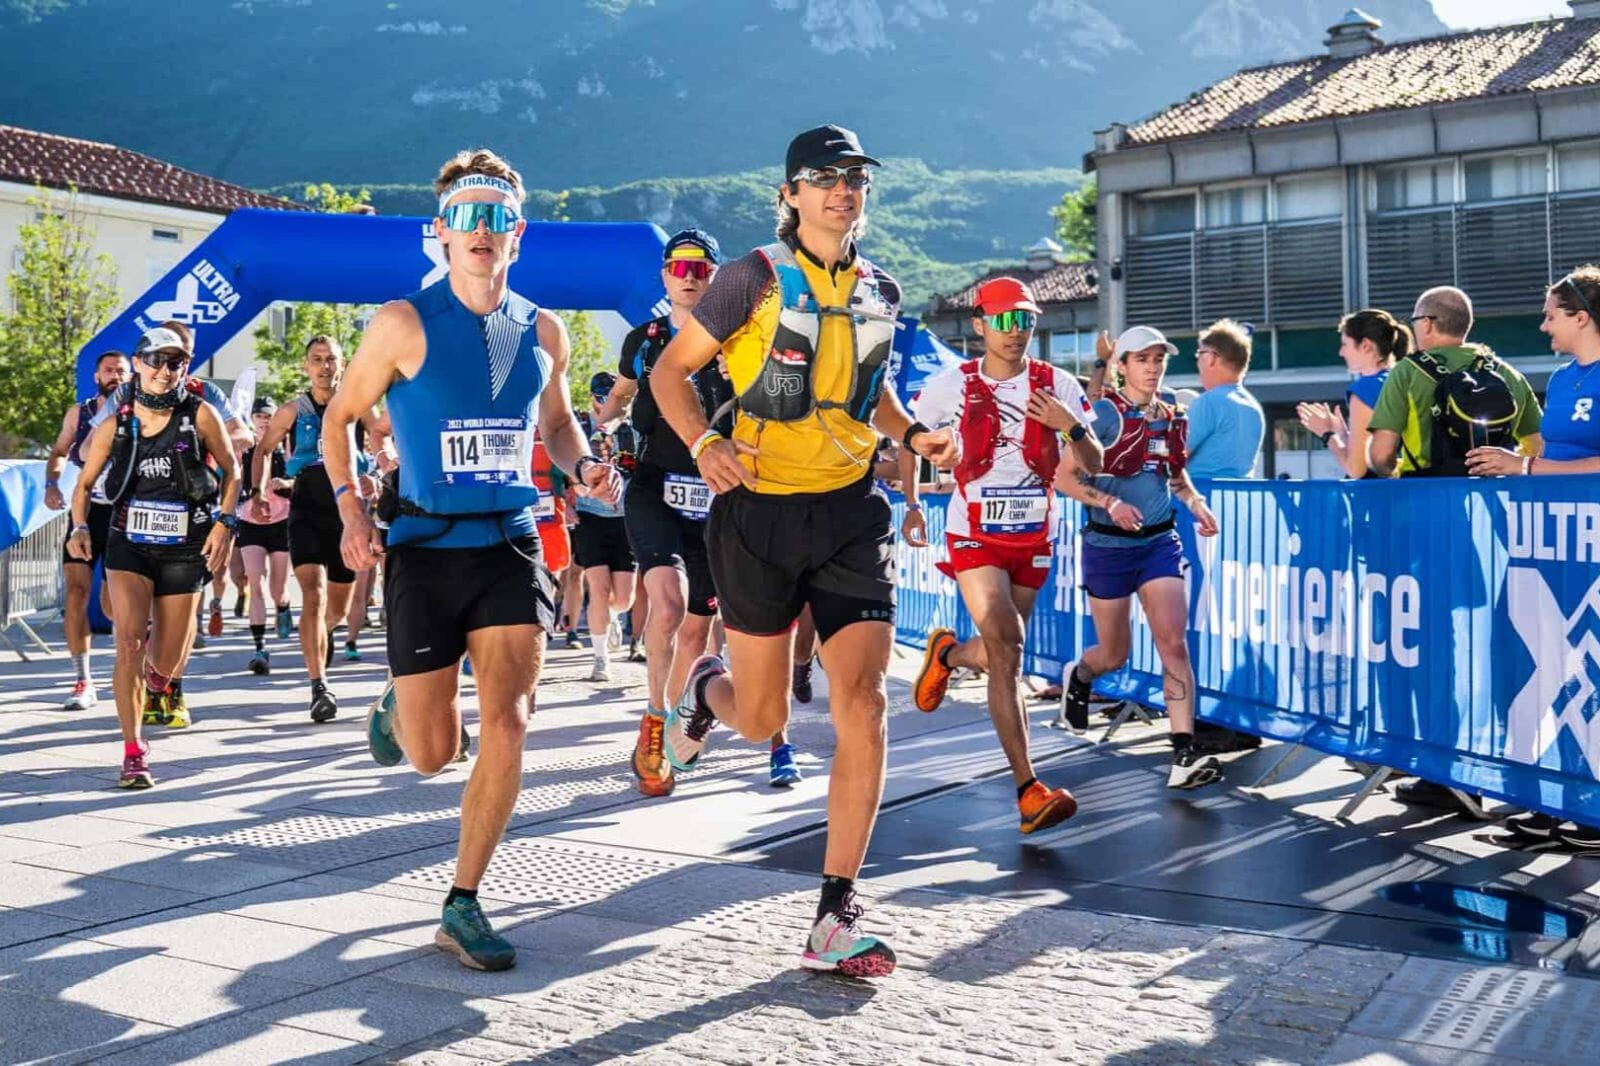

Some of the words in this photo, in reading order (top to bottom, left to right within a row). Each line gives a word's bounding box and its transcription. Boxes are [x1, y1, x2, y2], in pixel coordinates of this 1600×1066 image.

[192, 259, 241, 312] ULTRA
[448, 435, 480, 466] 114
[482, 434, 516, 447] THOMAS
[670, 485, 686, 505] 53
[986, 500, 1006, 520] 117
[1009, 499, 1035, 509] TOMMY
[1009, 510, 1026, 520] CHEN
[133, 511, 149, 530] 111
[1507, 501, 1600, 563] ULTR
